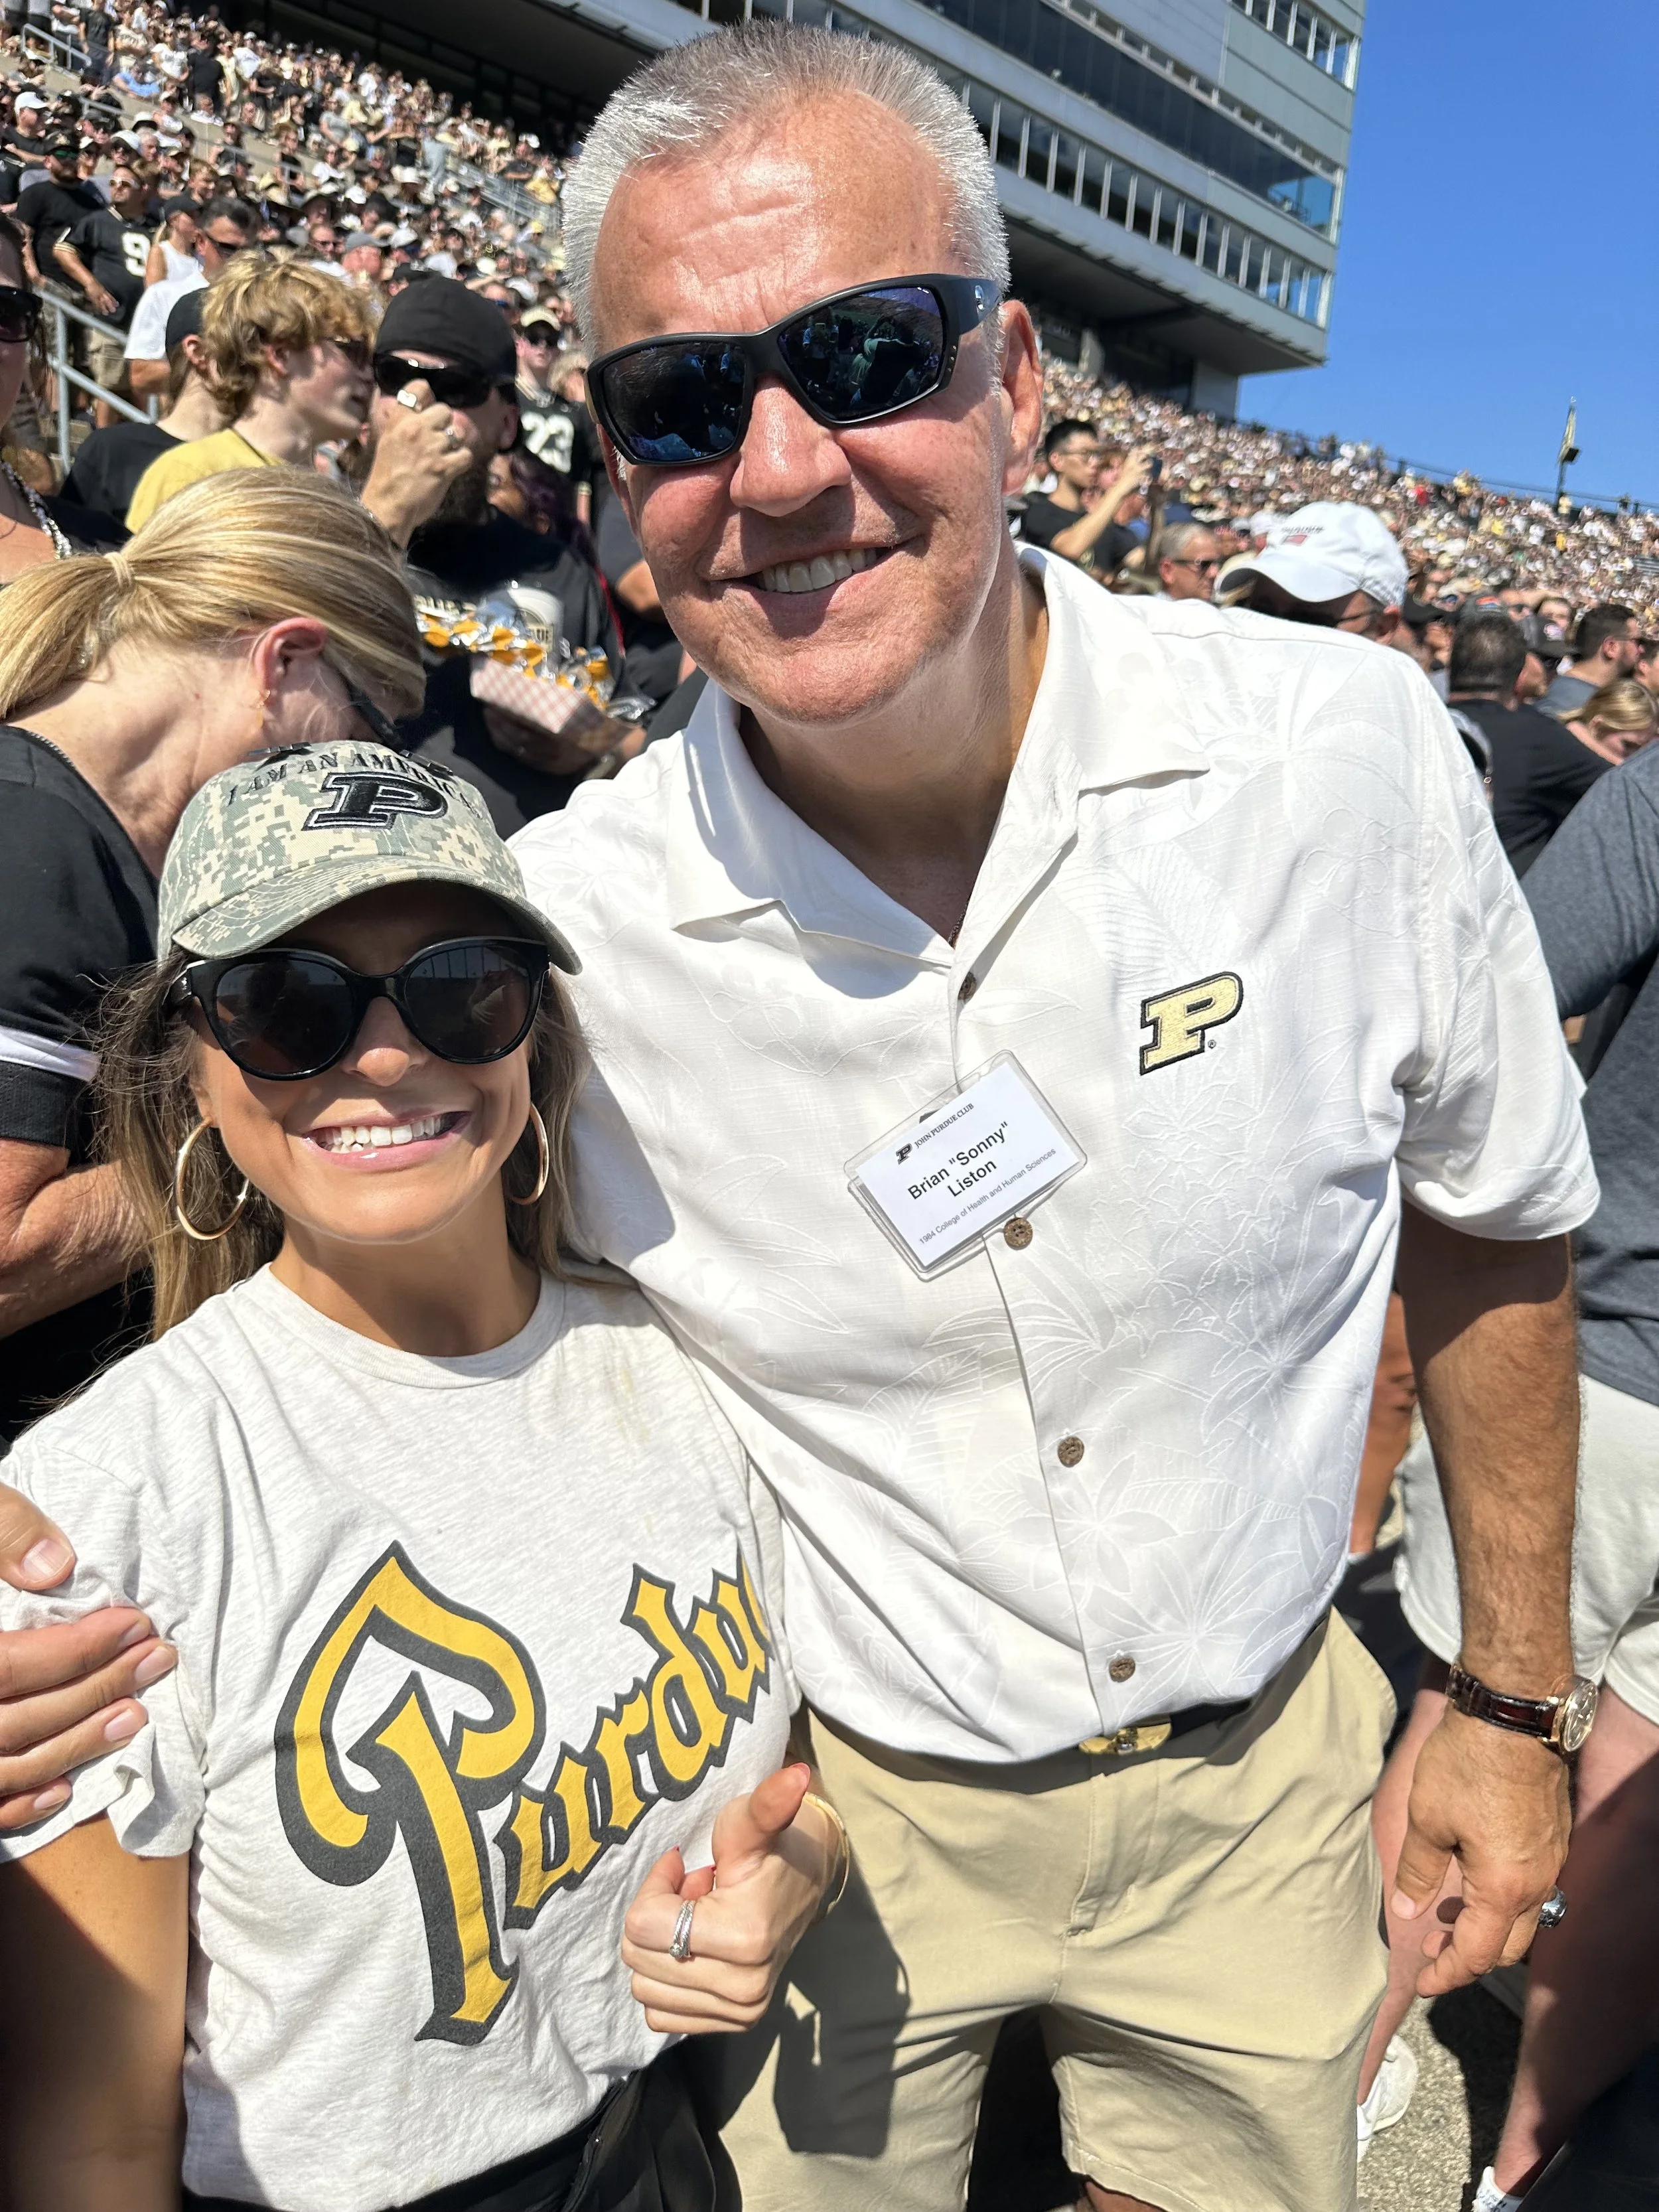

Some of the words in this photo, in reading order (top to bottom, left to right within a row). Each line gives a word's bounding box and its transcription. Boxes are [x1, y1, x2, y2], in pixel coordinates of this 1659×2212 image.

[227, 785, 238, 807] I
[243, 764, 287, 794] AM
[298, 753, 338, 774] AN
[302, 771, 448, 832] P
[1139, 971, 1244, 1076] P
[896, 1143, 912, 1165] P
[914, 1132, 932, 1149] JOHN
[930, 1114, 958, 1136] PURDUE
[956, 1103, 974, 1118] CLUB
[908, 1168, 950, 1200] Brian
[949, 1121, 1008, 1166] "Sonny"
[947, 1161, 997, 1197] Liston
[919, 1230, 936, 1244] 1984
[936, 1213, 961, 1234] College
[968, 1194, 989, 1213] Health
[989, 1185, 1003, 1197] and
[1002, 1169, 1027, 1189] Human
[1025, 1148, 1056, 1172] Sciences
[274, 1534, 775, 2045] Purdu
